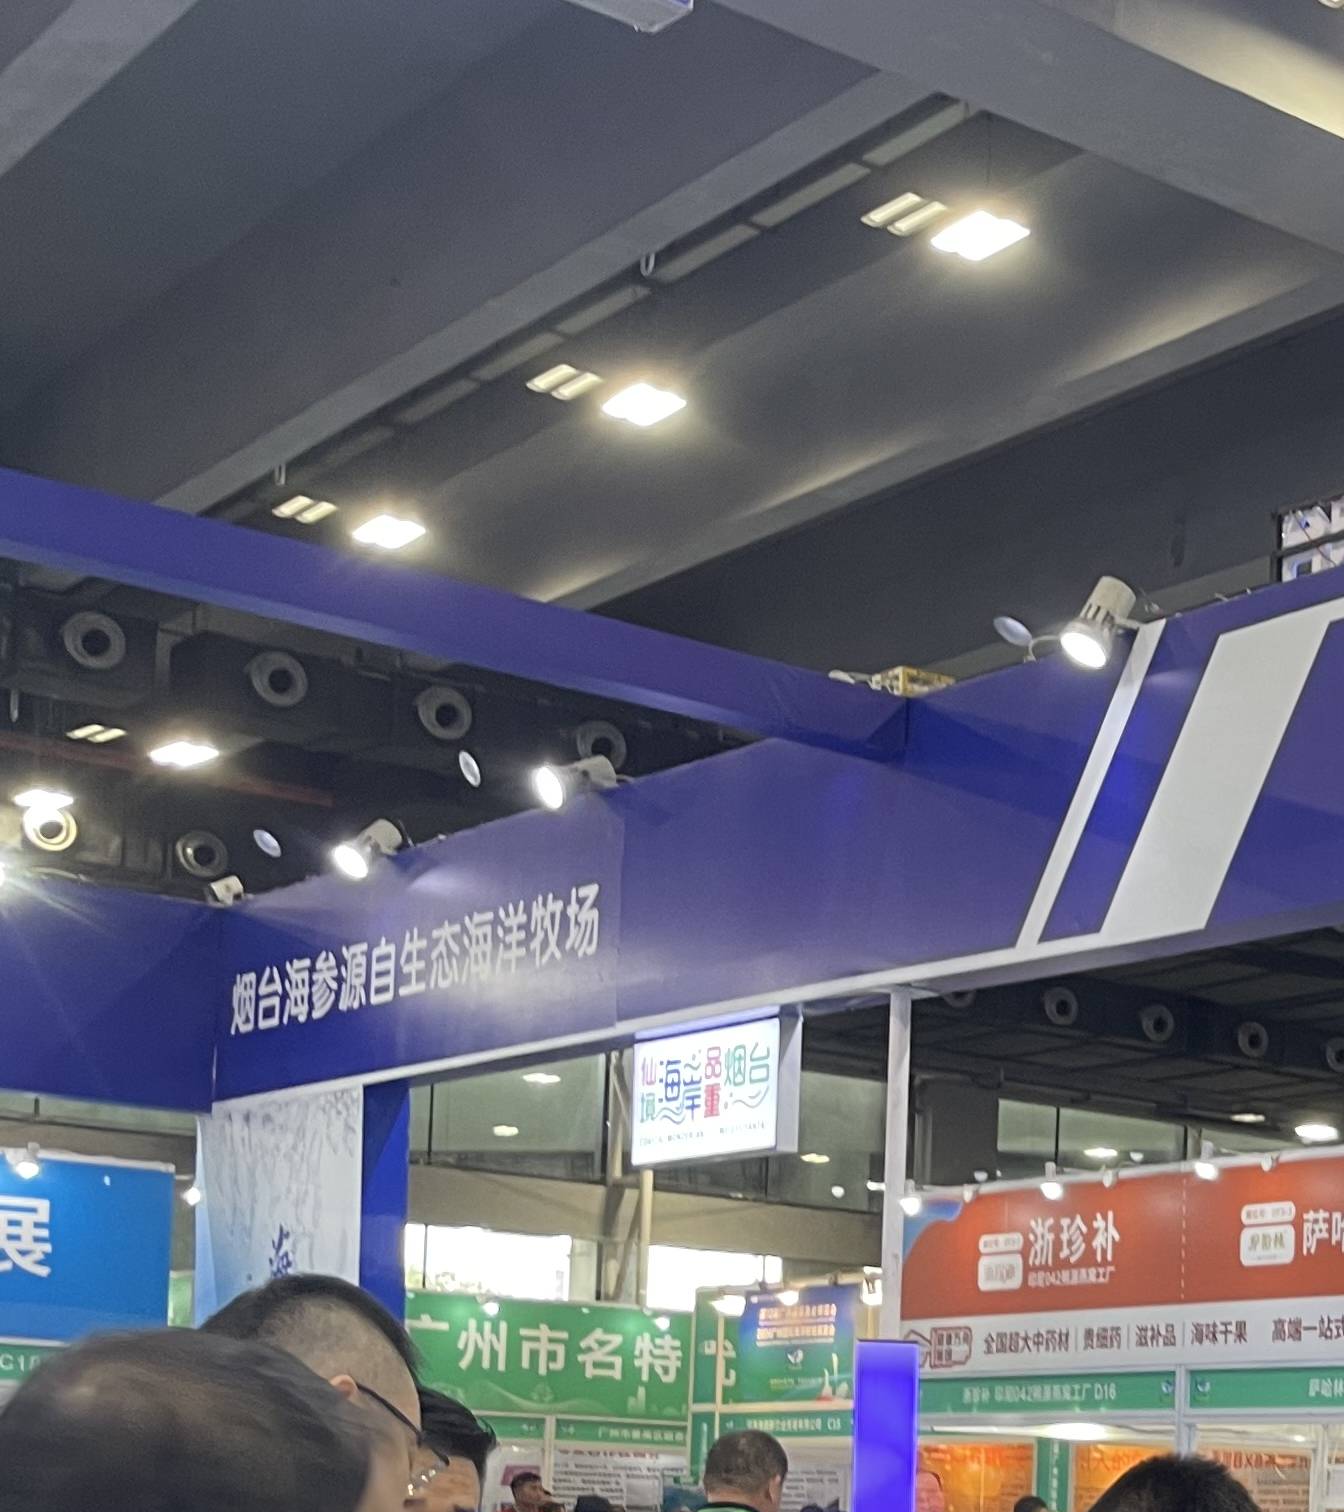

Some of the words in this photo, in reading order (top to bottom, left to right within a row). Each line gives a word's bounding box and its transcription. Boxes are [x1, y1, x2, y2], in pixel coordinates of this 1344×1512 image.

[231, 883, 600, 1036] 烟台海参源自生态海洋牧场
[983, 1327, 1070, 1356] 全国超大中药材
